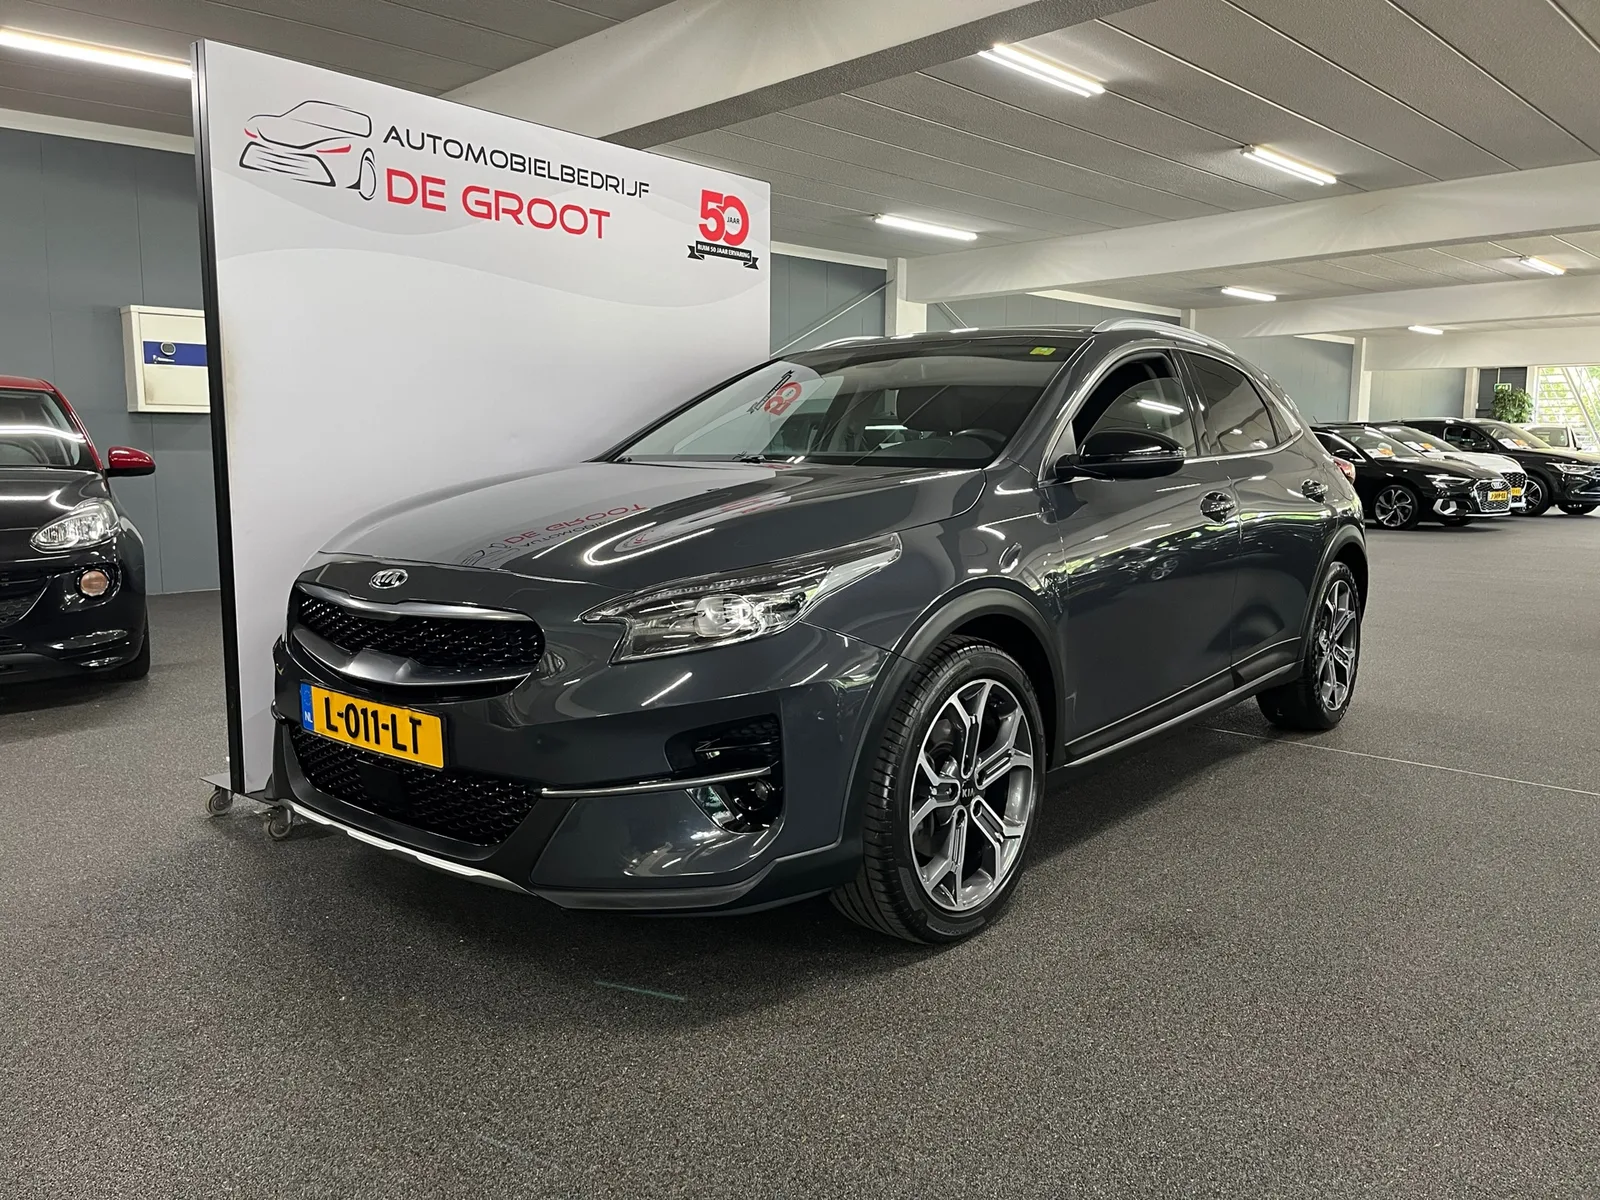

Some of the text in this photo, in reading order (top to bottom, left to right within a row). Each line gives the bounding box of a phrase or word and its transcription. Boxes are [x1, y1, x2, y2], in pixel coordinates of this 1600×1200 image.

[382, 124, 650, 199] AUTOMOBIELBEDRIJF
[386, 168, 611, 239] DE GROOT
[698, 189, 750, 247] 50
[727, 216, 740, 224] JAAR
[728, 250, 750, 259] ERVARING
[304, 711, 314, 723] NL
[324, 696, 422, 755] L-011-LT
